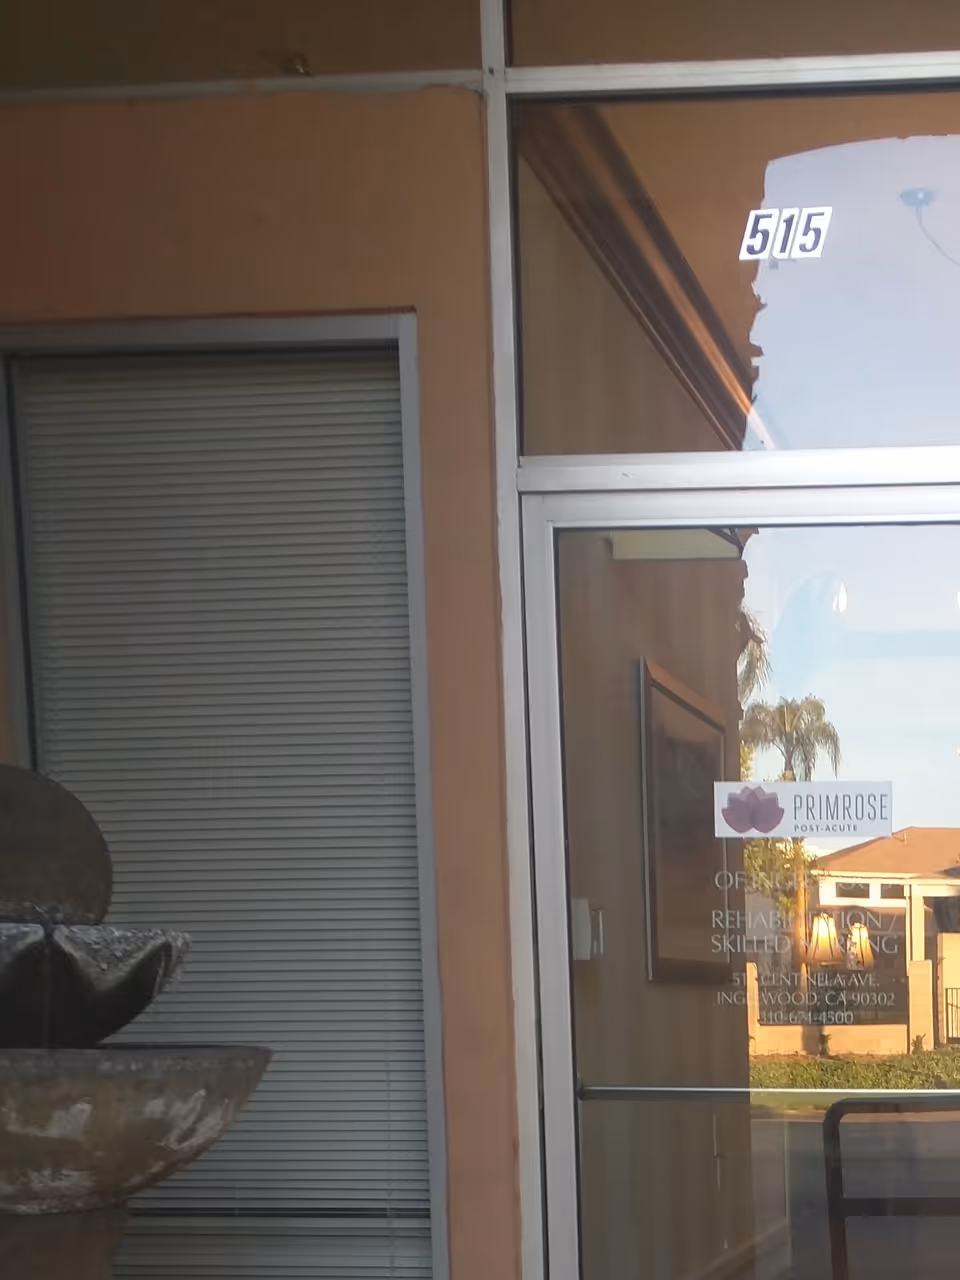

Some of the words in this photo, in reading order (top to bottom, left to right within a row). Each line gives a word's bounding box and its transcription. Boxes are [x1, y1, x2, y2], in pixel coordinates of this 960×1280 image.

[746, 211, 825, 255] 515
[793, 793, 888, 821] PRIMROSE
[794, 824, 857, 832] POST-ACUTE
[714, 870, 743, 890] OF
[761, 972, 843, 987] CENTNELA
[717, 991, 820, 1006] INGWOOD,
[825, 991, 847, 1006] CA
[852, 991, 895, 1006] 90302
